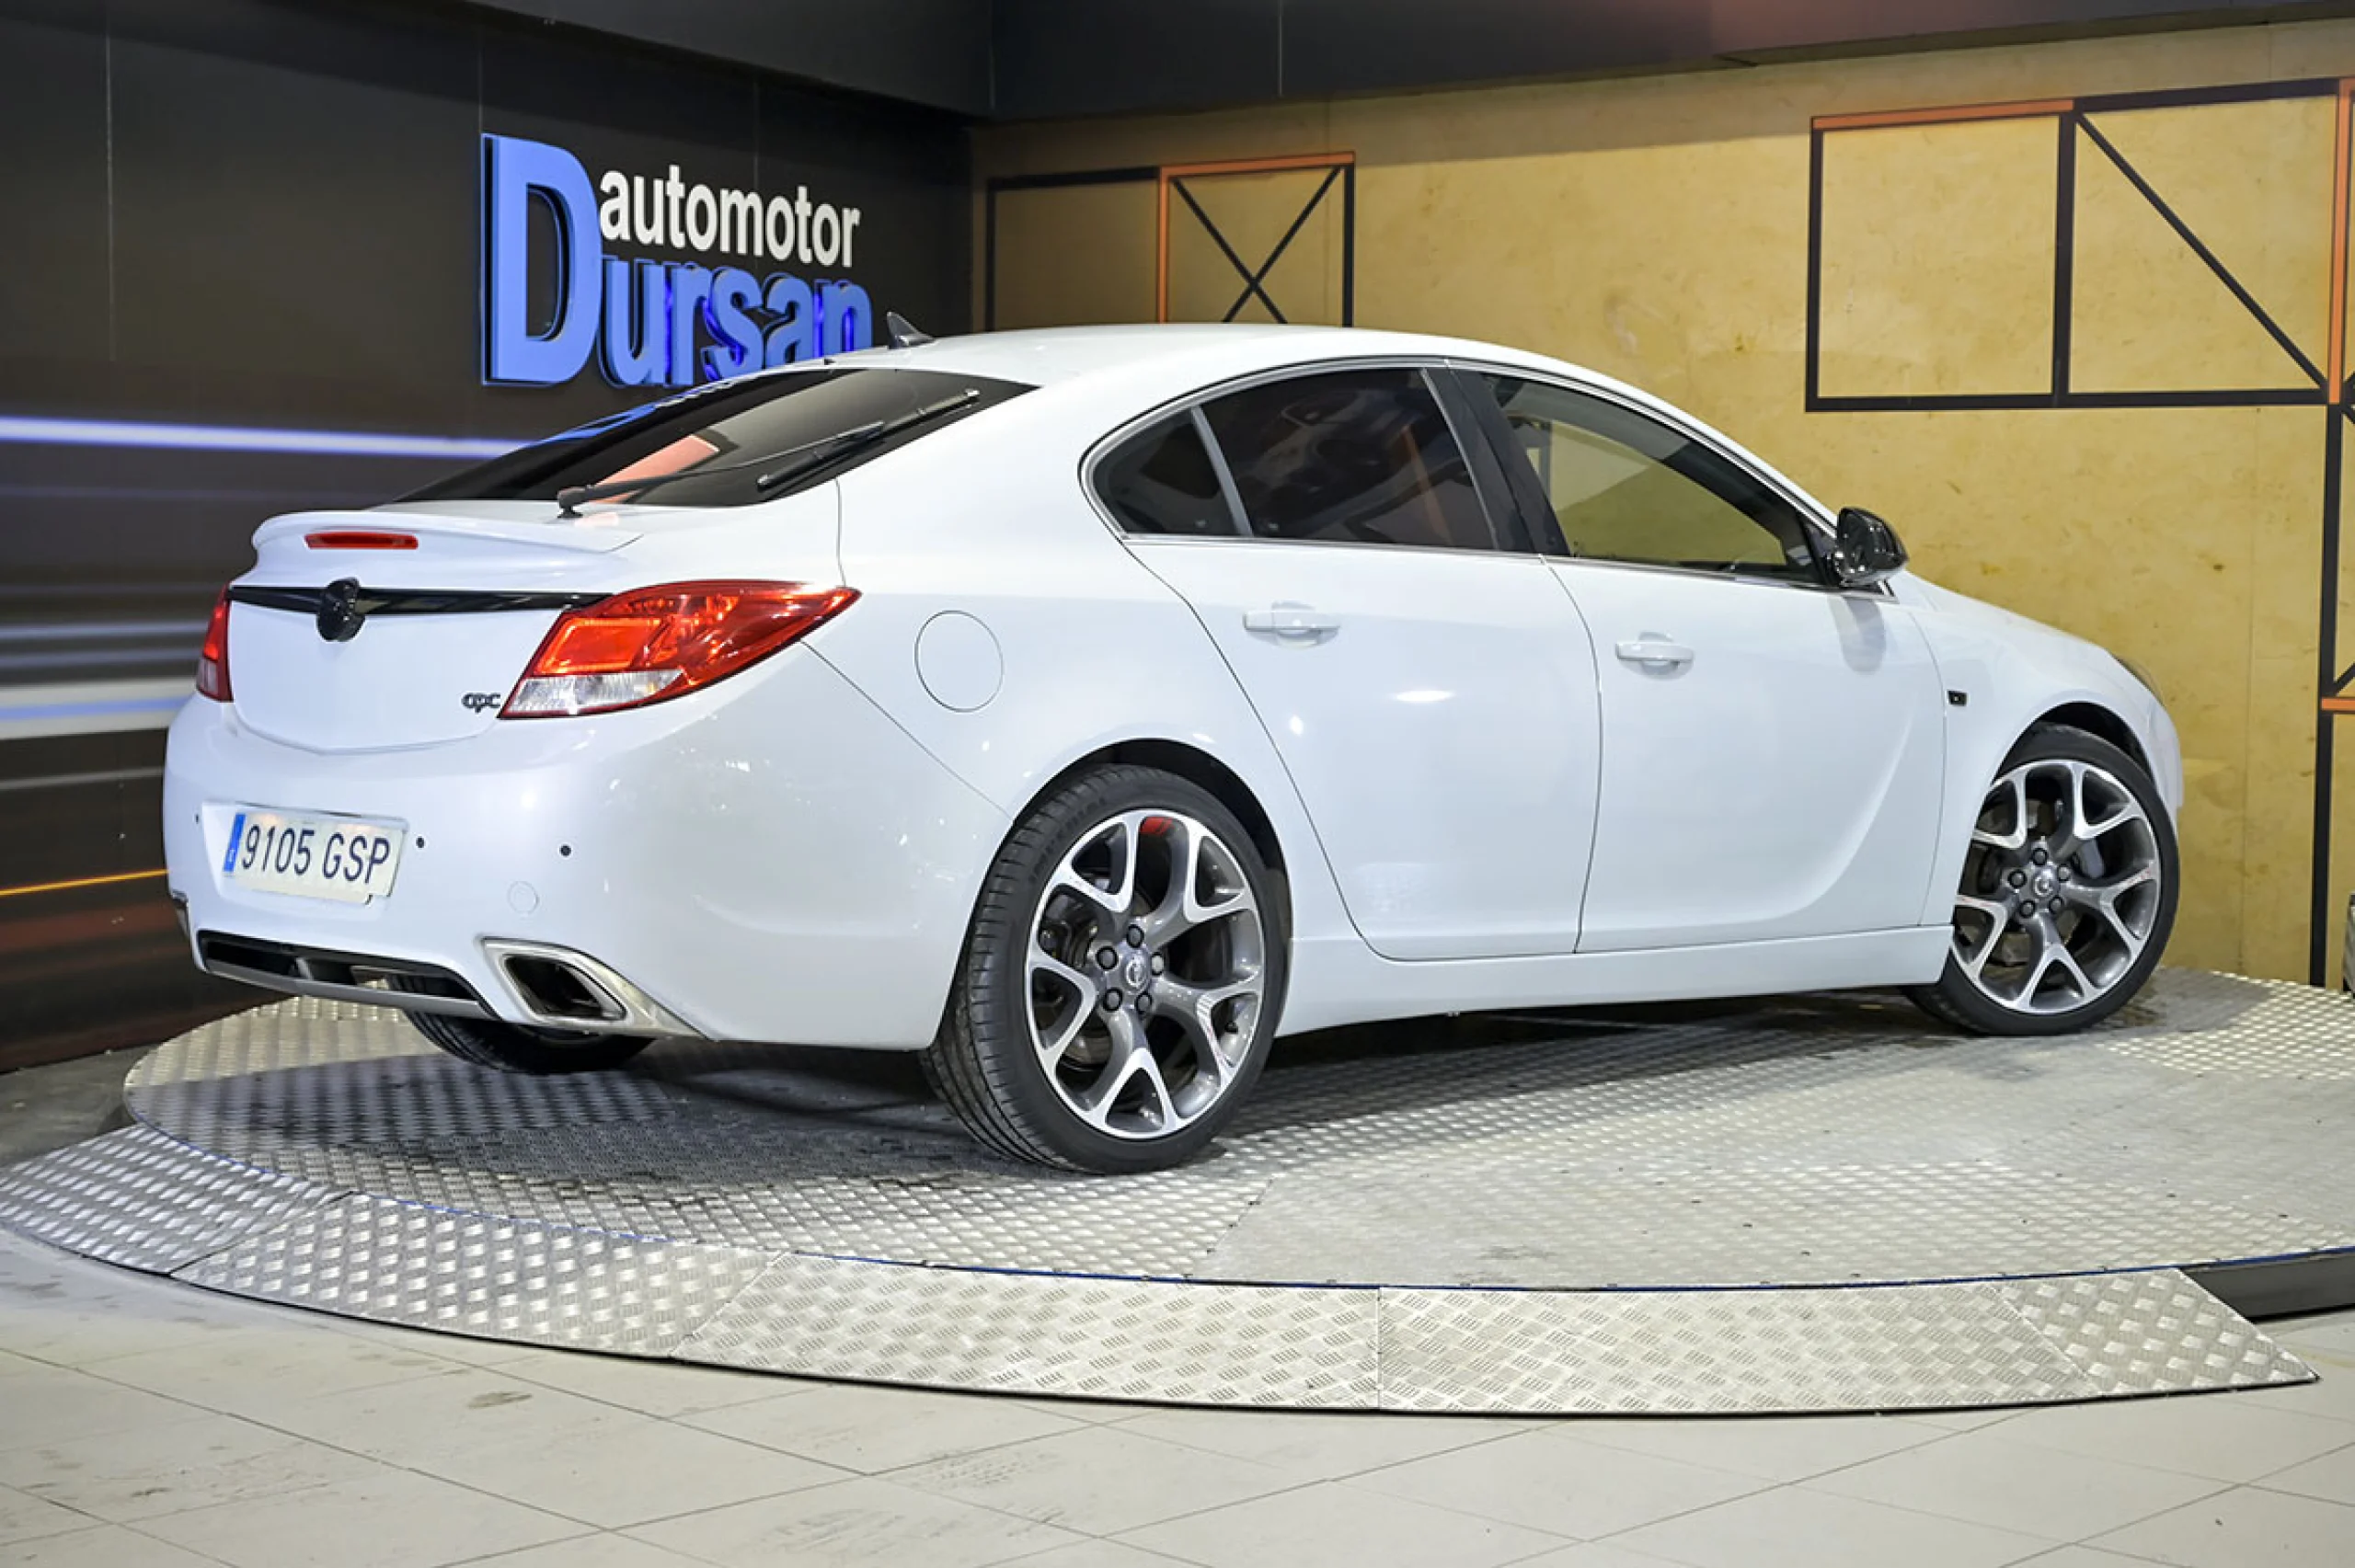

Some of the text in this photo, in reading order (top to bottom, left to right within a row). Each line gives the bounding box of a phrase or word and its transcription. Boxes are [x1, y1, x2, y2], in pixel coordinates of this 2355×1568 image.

[481, 132, 875, 389] Dursan
[600, 164, 861, 268] automotor
[242, 823, 391, 885] 9105 GSP
